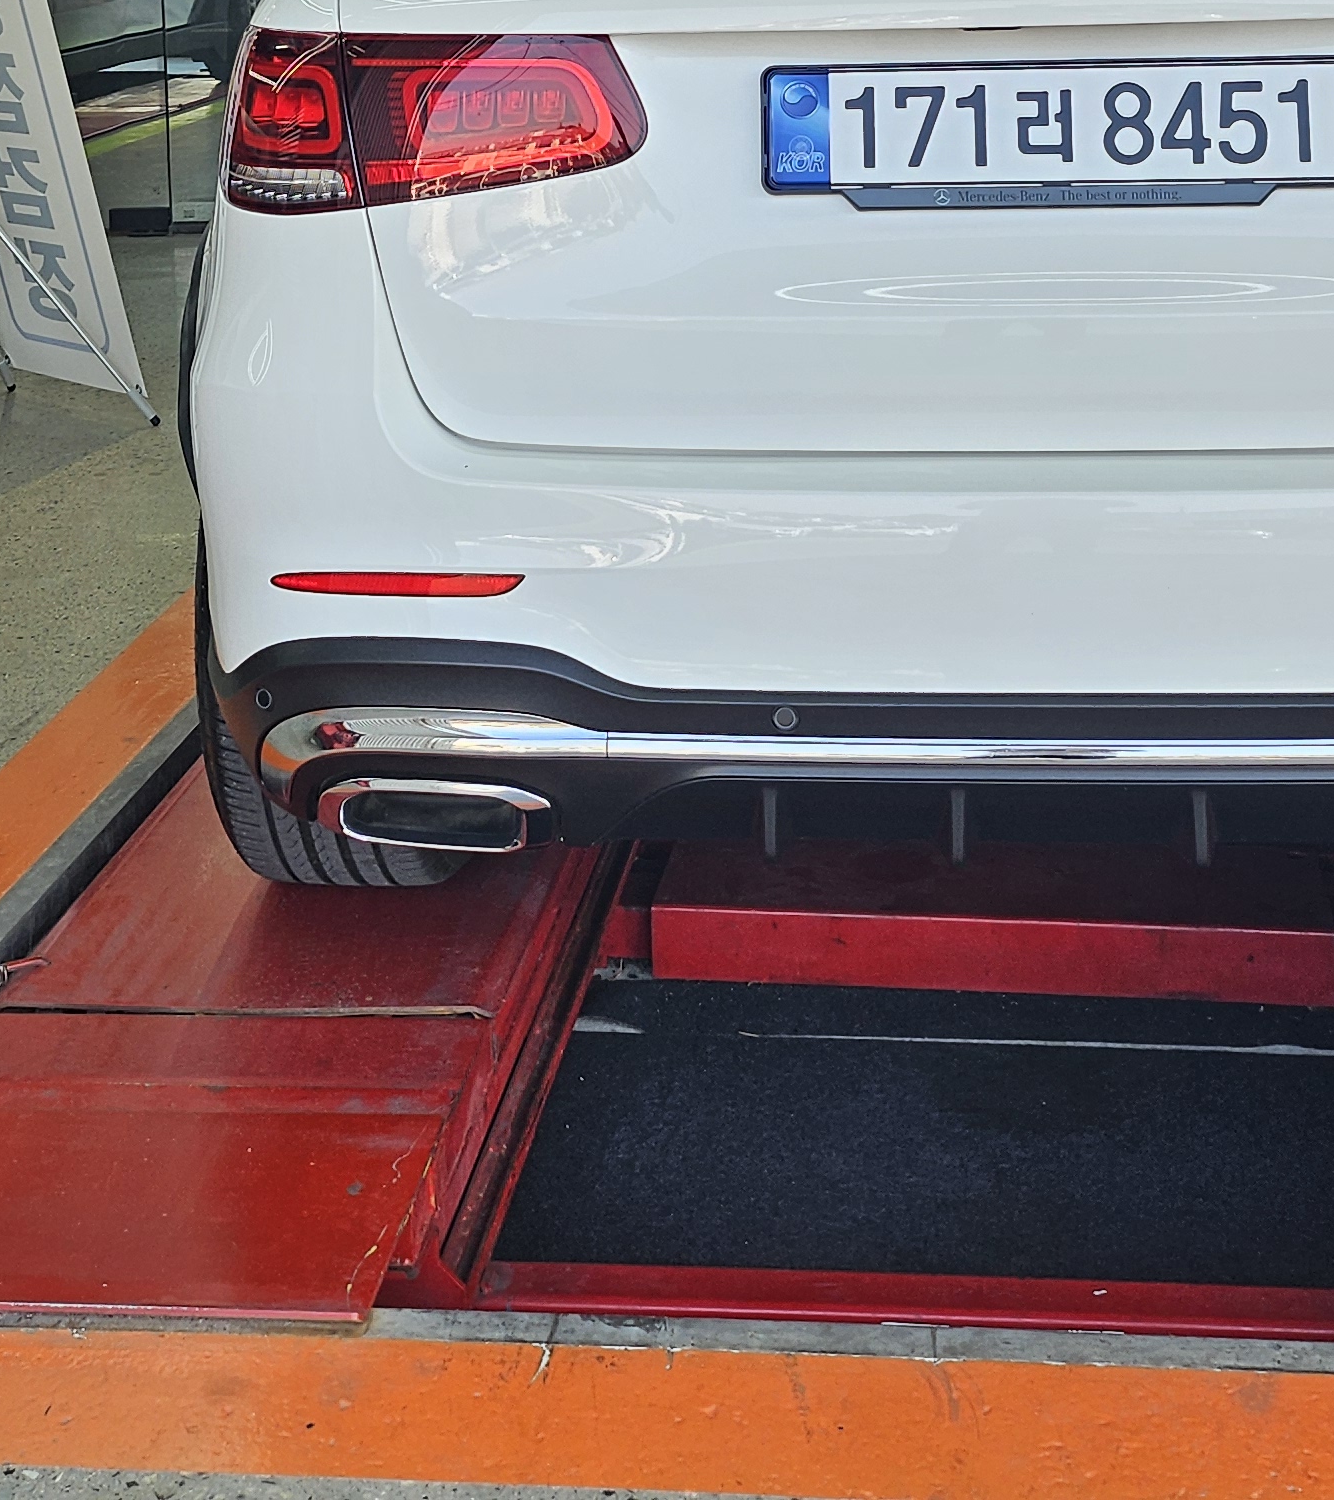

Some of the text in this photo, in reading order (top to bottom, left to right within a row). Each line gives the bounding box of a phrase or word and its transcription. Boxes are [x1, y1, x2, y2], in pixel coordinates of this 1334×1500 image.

[1103, 78, 1313, 165] 8451
[776, 151, 826, 173] KOR
[958, 187, 1183, 203] Mercedes-Benz The best or nothing.
